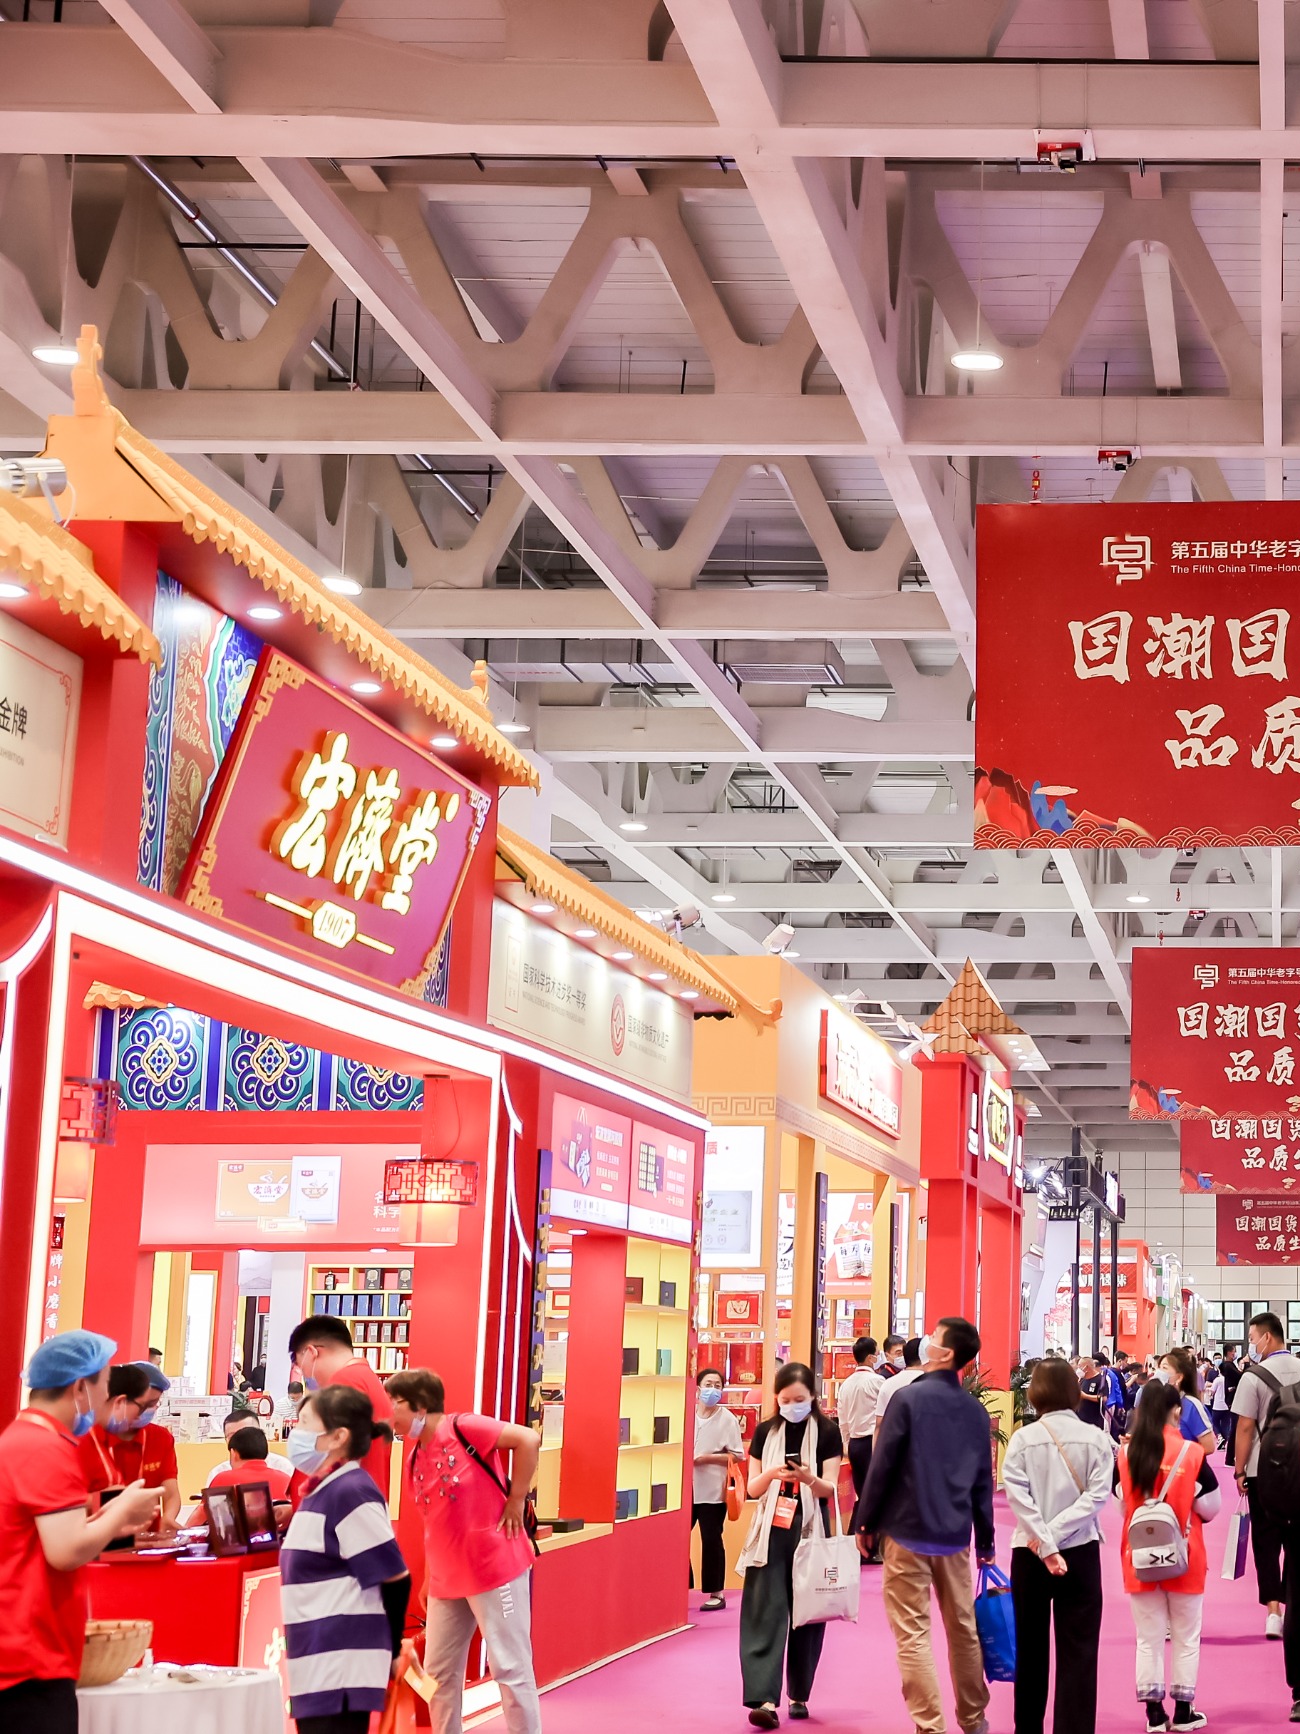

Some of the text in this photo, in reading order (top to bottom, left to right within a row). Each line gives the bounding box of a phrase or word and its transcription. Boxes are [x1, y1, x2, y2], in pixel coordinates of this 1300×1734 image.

[1171, 565, 1189, 574] The
[1192, 564, 1215, 574] Fifth
[1217, 563, 1246, 573] China
[318, 909, 352, 941] 1907
[1235, 1215, 1297, 1232] 国潮国货
